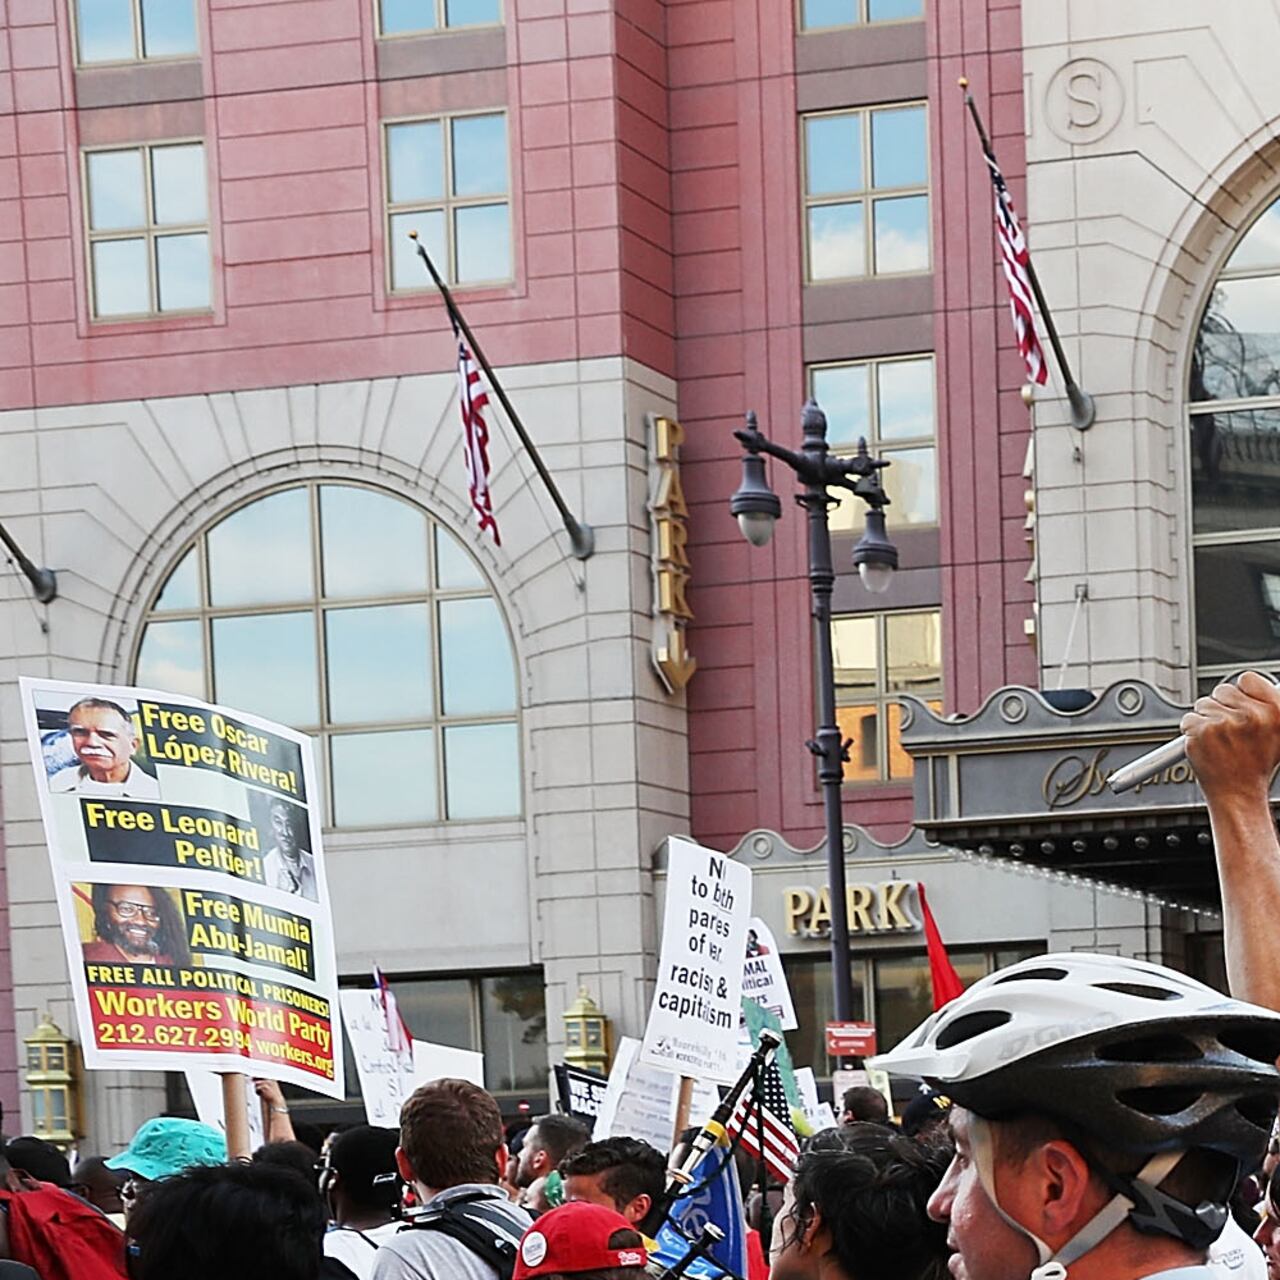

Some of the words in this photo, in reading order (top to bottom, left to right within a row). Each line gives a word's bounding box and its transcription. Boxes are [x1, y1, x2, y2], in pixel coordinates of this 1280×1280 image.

[655, 416, 695, 620] PARK
[142, 702, 206, 734] Free
[210, 713, 268, 756] Oscar
[146, 733, 227, 770] López
[227, 748, 298, 795] Rivera!
[85, 802, 155, 831] Free
[161, 808, 260, 850] Leonard
[175, 839, 263, 881] Peltier!
[709, 857, 727, 880] N
[692, 875, 708, 898] to
[783, 883, 912, 932] PARK
[185, 891, 241, 923] Free
[243, 903, 311, 944] Mumia
[191, 923, 309, 974] Abu-Jamal!
[689, 933, 707, 956] of
[87, 964, 136, 984] FREE
[142, 968, 175, 987] ALL
[181, 970, 259, 998] POLITICAL
[263, 986, 330, 1019] PRISONERS!
[716, 976, 728, 1000] &
[94, 989, 224, 1021] Workers
[226, 995, 285, 1035] World
[288, 1010, 332, 1053] Party
[98, 1022, 253, 1053] 212.627.2994
[256, 1036, 334, 1080] workers.org
